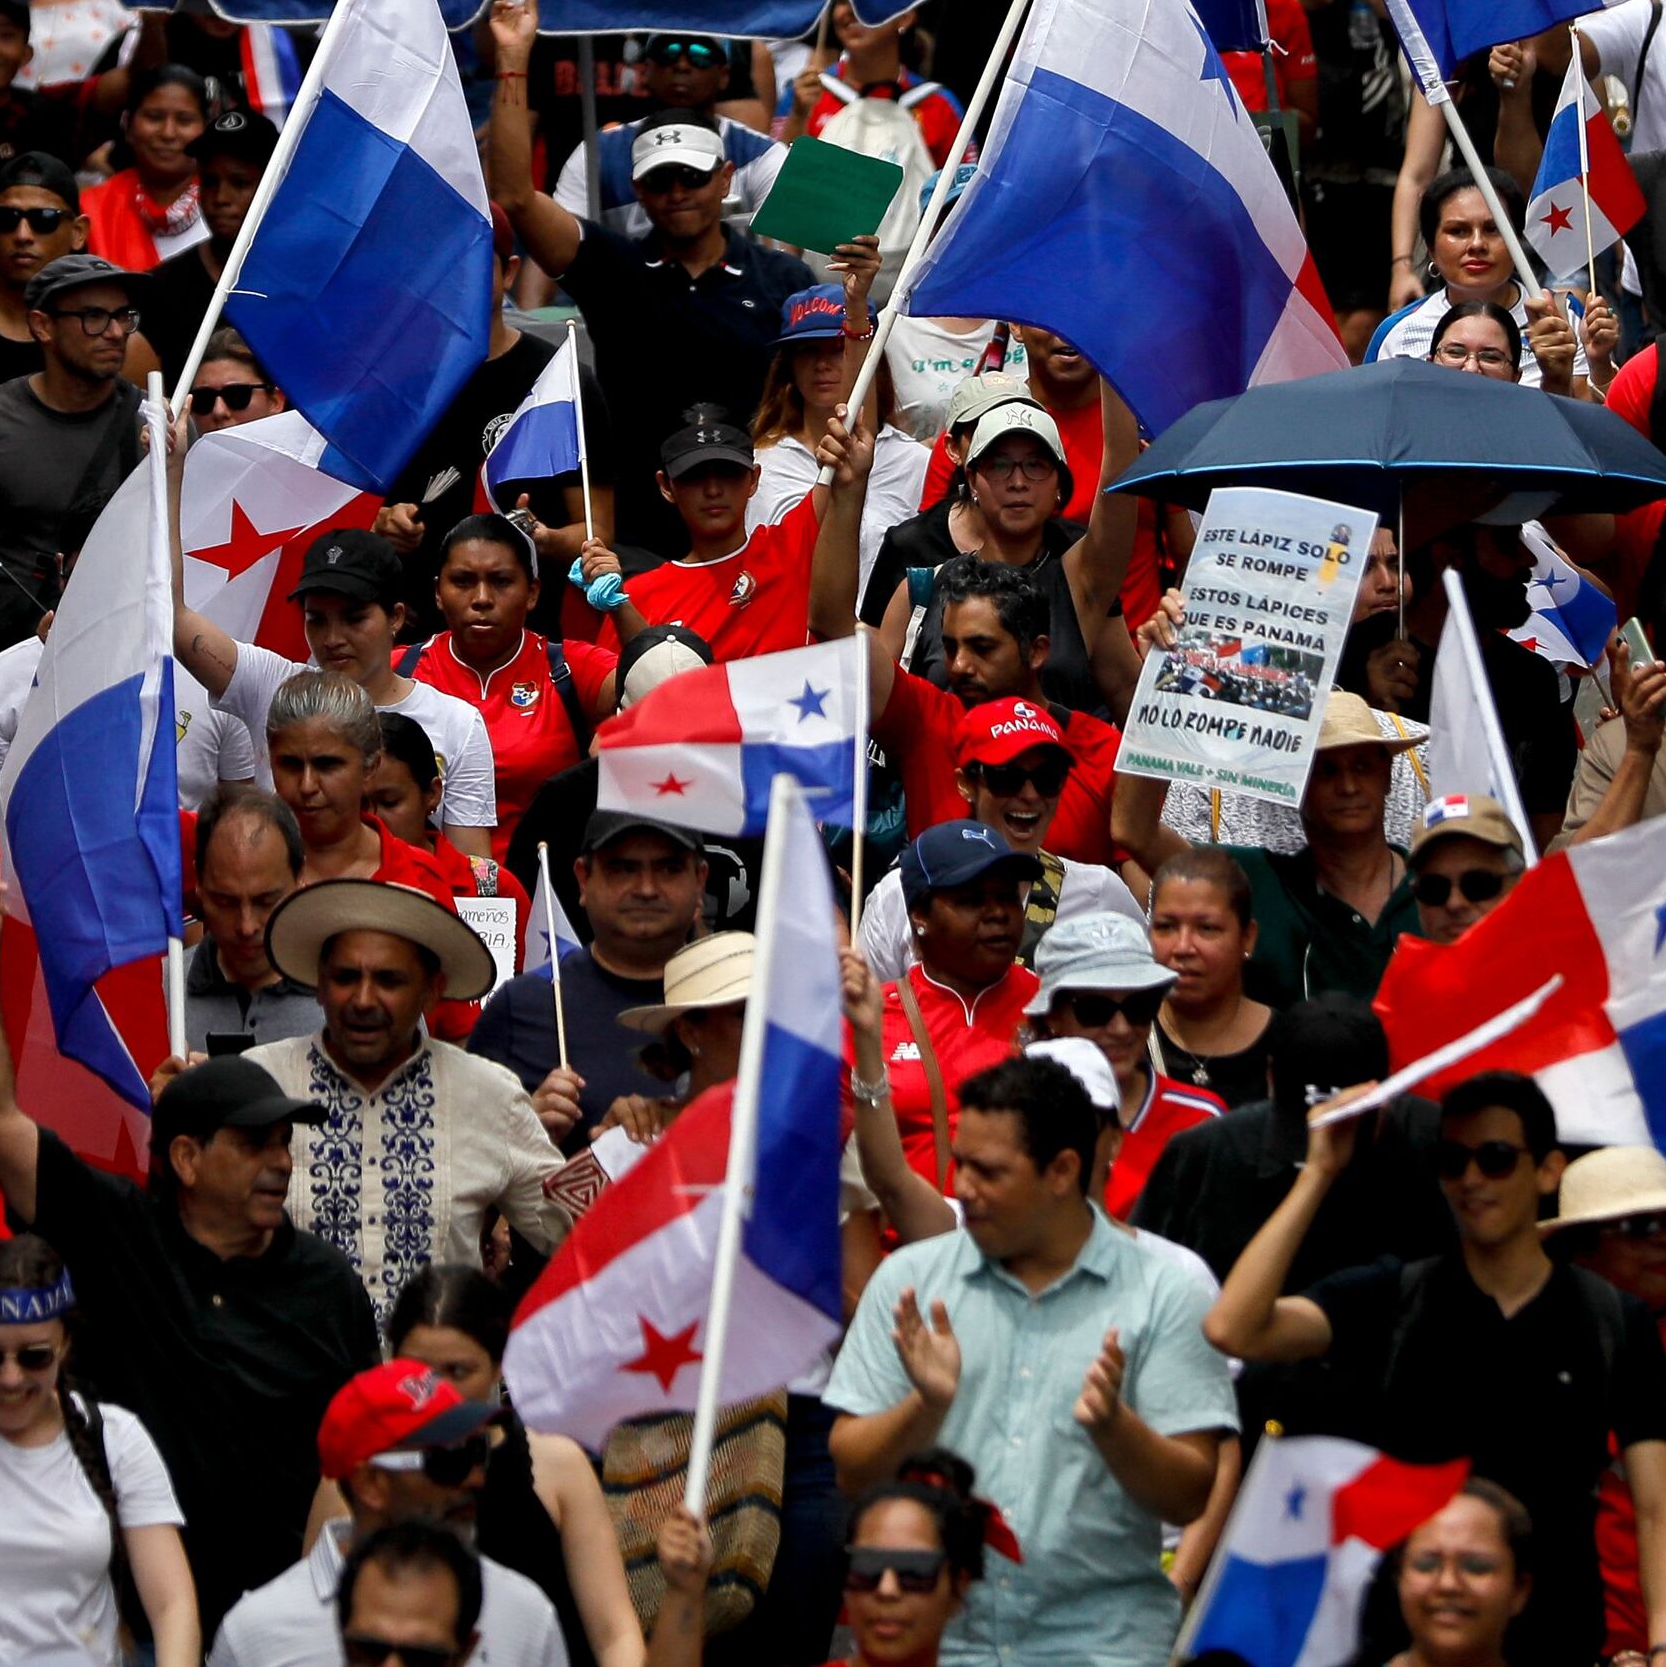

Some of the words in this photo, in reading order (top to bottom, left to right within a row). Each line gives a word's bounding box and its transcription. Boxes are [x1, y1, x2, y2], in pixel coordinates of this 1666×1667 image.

[1203, 528, 1236, 543] ESTE
[1239, 529, 1293, 552] LÁPIZ
[1296, 541, 1351, 565] SOLO
[1215, 552, 1238, 567] SE
[1241, 556, 1309, 582] ROMPE
[1190, 587, 1242, 606] ESTOS
[1246, 594, 1329, 625] LÁPICES
[1214, 615, 1238, 631] ES
[1242, 620, 1326, 652] PANAMÁ
[1138, 703, 1159, 725] NO
[1160, 705, 1182, 729] LO
[1183, 711, 1248, 740] ROMPE
[1249, 725, 1304, 753] NADIE
[1176, 759, 1204, 776] VALE
[1215, 769, 1238, 784] SIN
